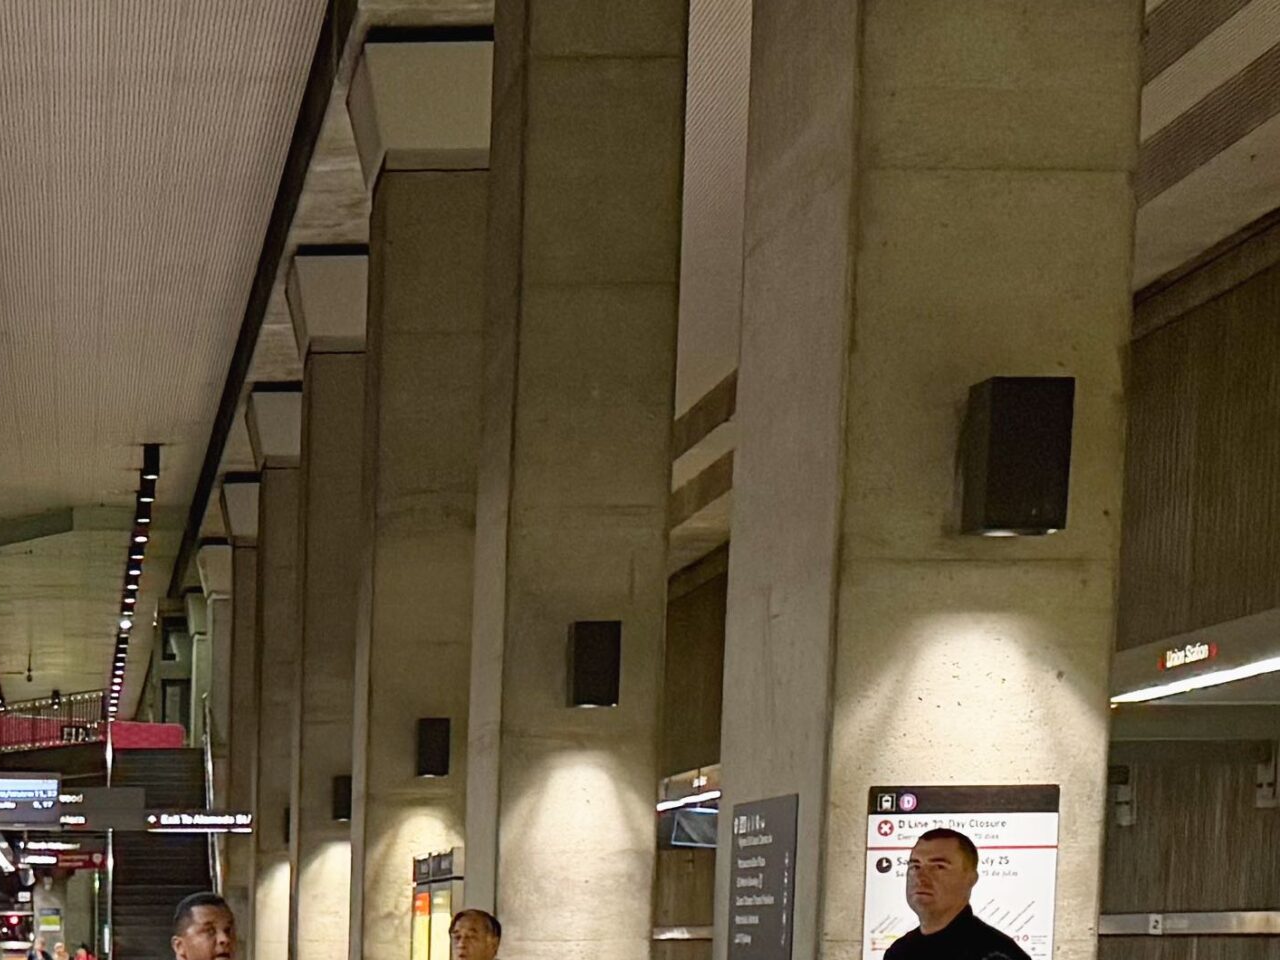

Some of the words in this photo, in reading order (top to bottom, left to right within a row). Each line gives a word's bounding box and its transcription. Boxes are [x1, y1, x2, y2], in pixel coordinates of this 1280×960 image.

[1166, 648, 1185, 668] Union
[1185, 642, 1209, 663] Station
[898, 819, 906, 829] D
[908, 819, 929, 829] Line
[969, 818, 1007, 828] Closure
